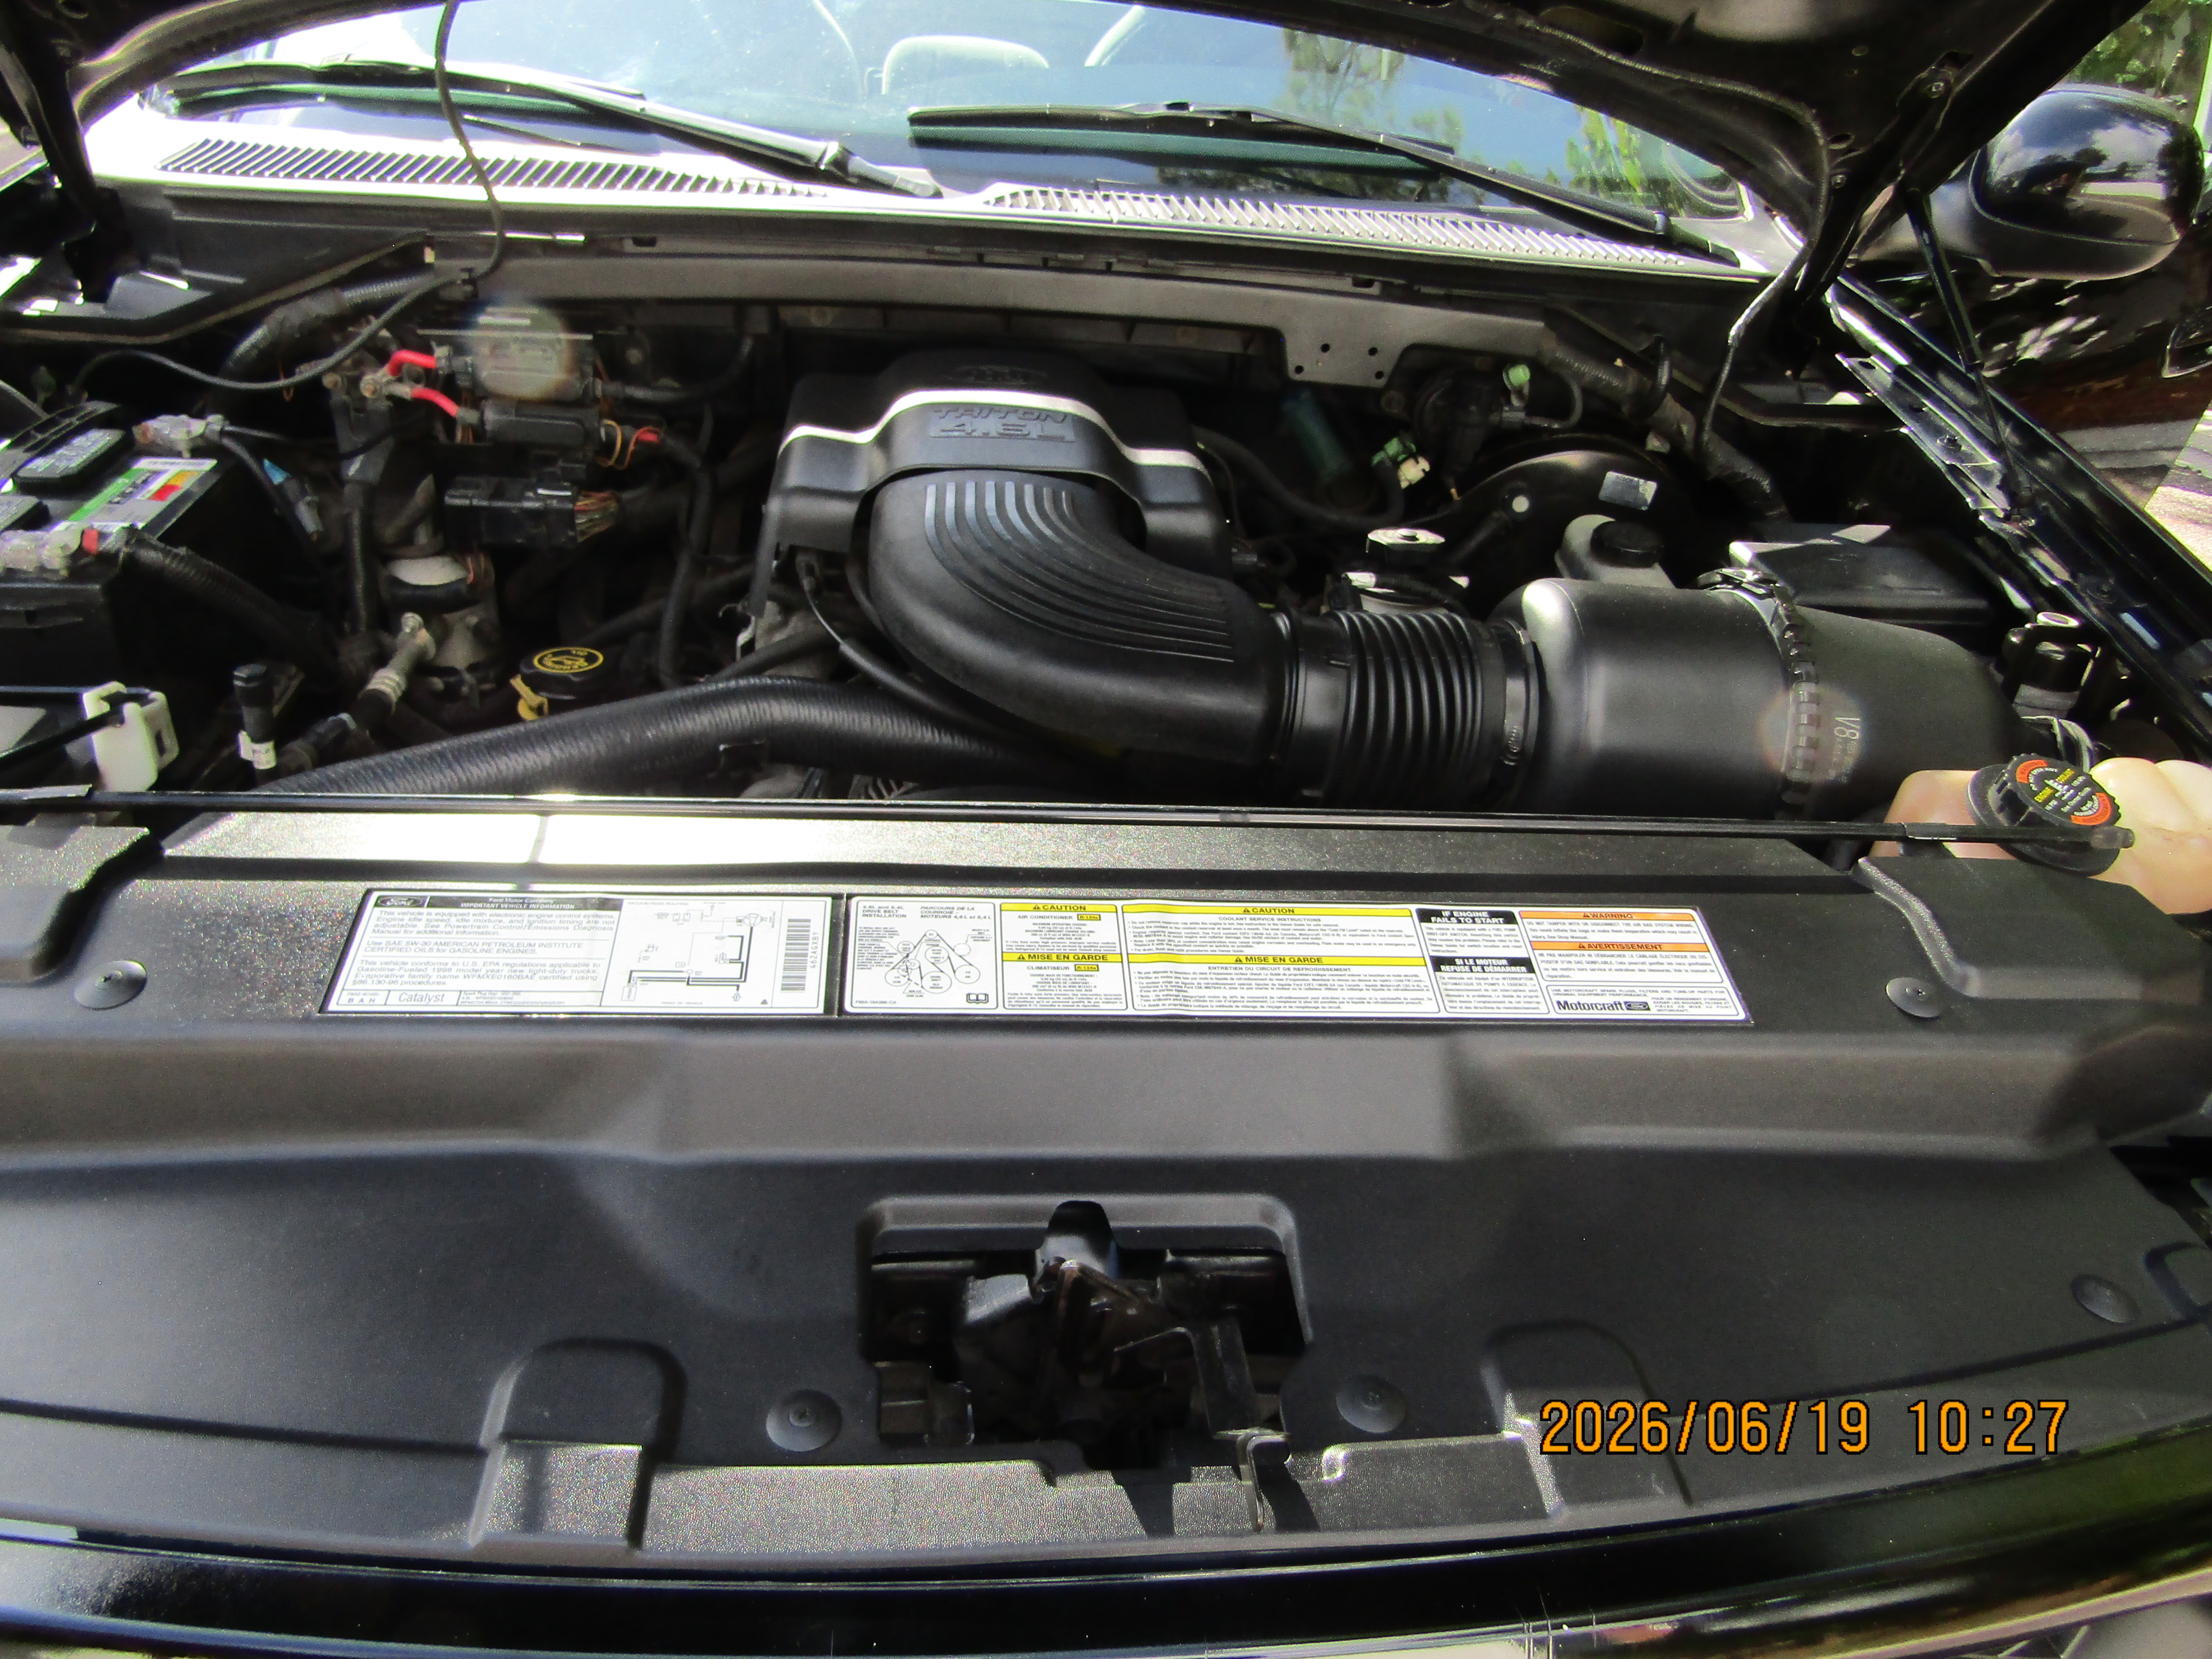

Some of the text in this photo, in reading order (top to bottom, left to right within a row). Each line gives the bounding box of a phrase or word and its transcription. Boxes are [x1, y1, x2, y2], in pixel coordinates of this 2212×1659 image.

[933, 407, 1067, 424] TRITON
[940, 422, 1066, 441] 4.6L
[1834, 717, 1860, 739] V8
[2034, 787, 2054, 802] ENGINE
[2056, 769, 2075, 783] COOLANT
[399, 993, 445, 1004] Catalyst
[1556, 1000, 1625, 1011] Motorcraft
